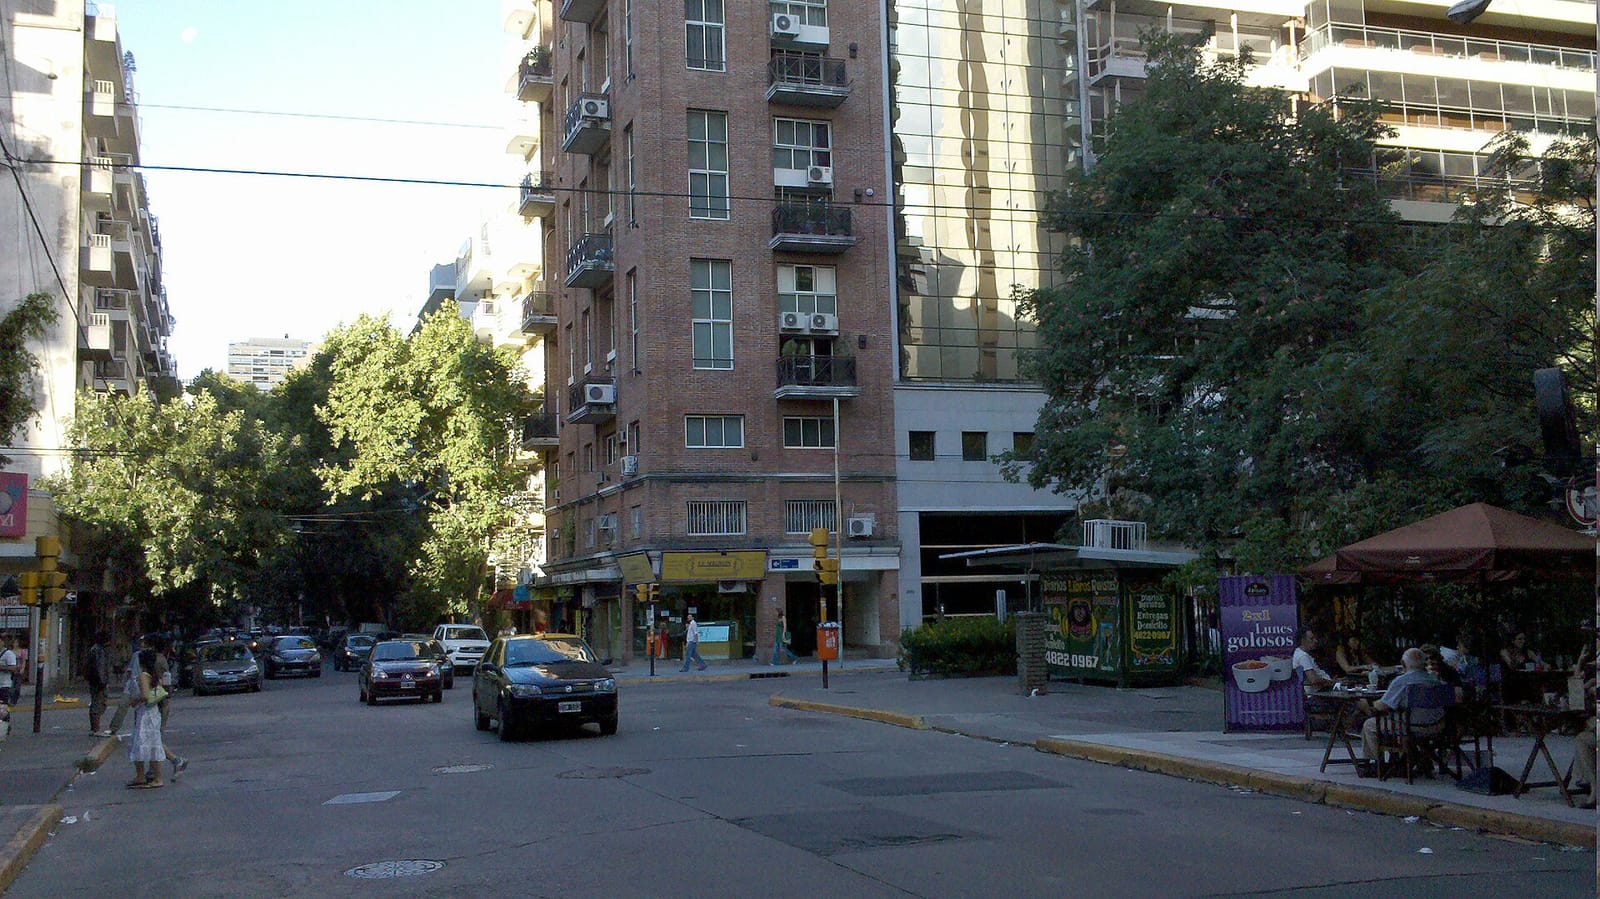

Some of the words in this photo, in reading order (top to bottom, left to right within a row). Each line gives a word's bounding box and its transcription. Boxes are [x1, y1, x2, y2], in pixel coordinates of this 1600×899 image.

[1137, 611, 1169, 622] Entregas
[1242, 610, 1271, 622] 2x1
[1255, 623, 1294, 635] Lunes
[1227, 631, 1294, 653] golosos
